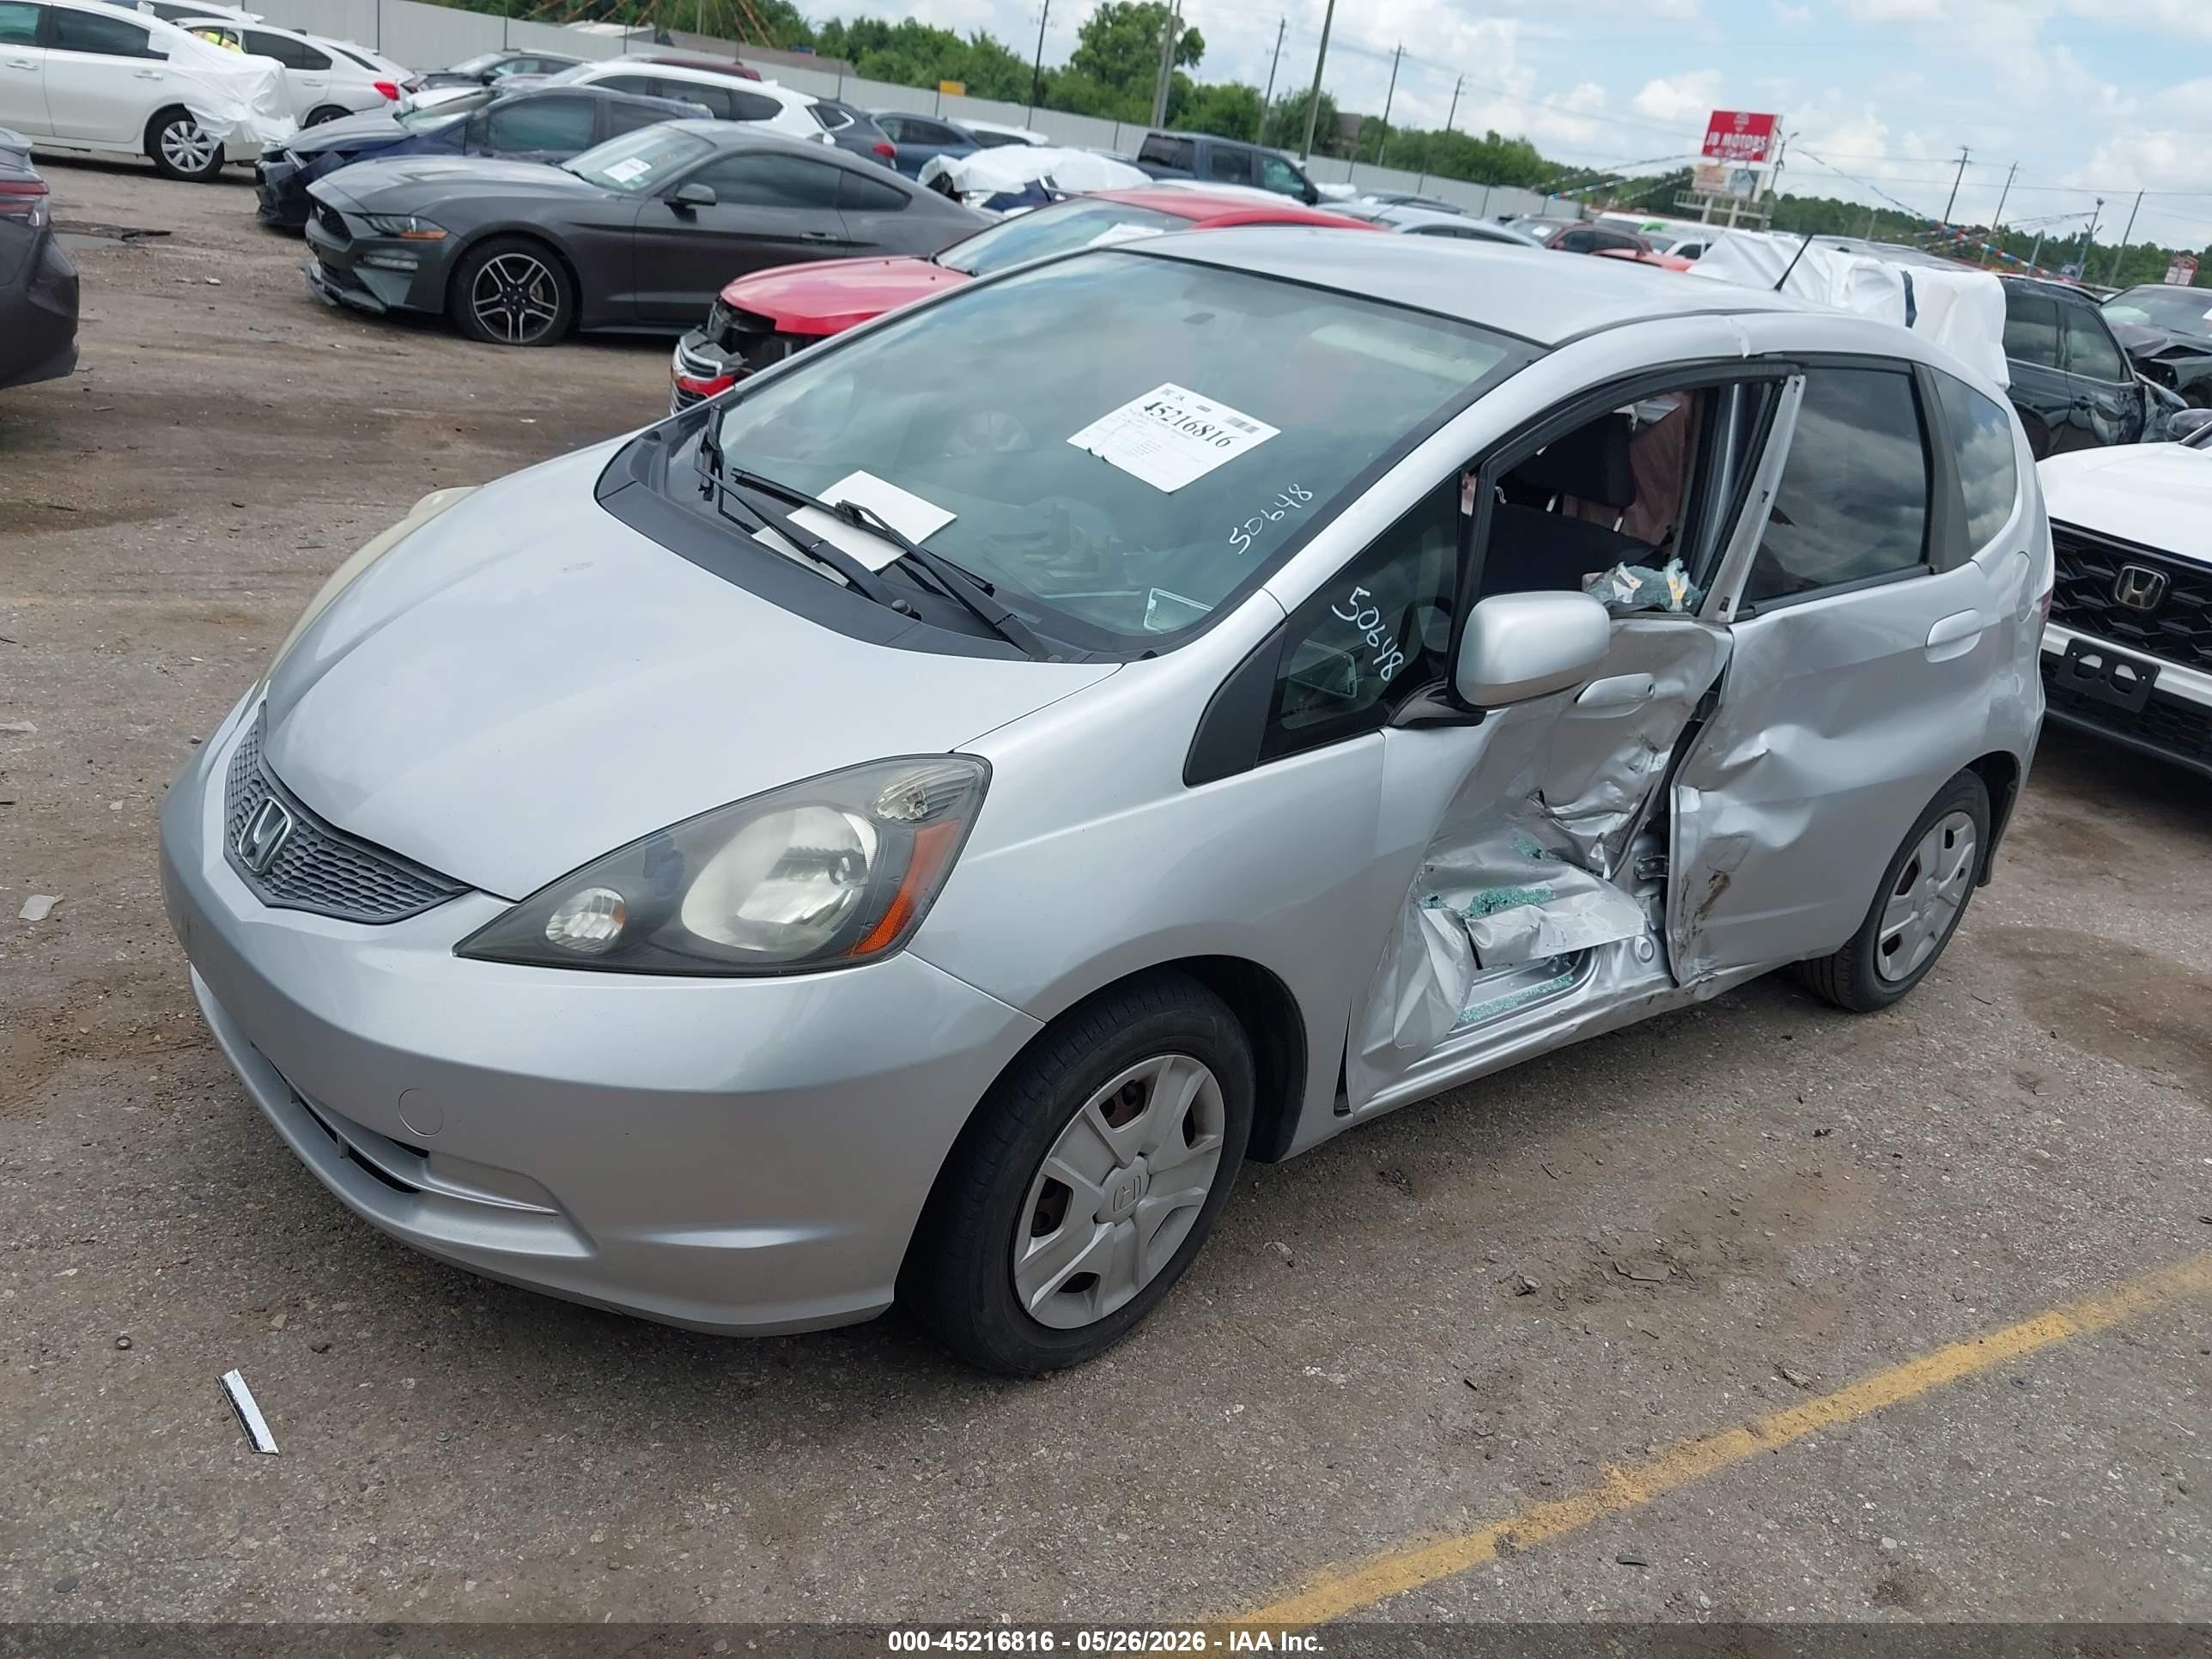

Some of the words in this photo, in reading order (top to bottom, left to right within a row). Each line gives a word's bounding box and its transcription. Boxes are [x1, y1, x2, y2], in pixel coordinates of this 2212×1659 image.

[1720, 132, 1767, 150] MOTORS
[1144, 401, 1237, 448] 45216816
[1229, 483, 1313, 555] 50648
[1331, 586, 1404, 682] 50648
